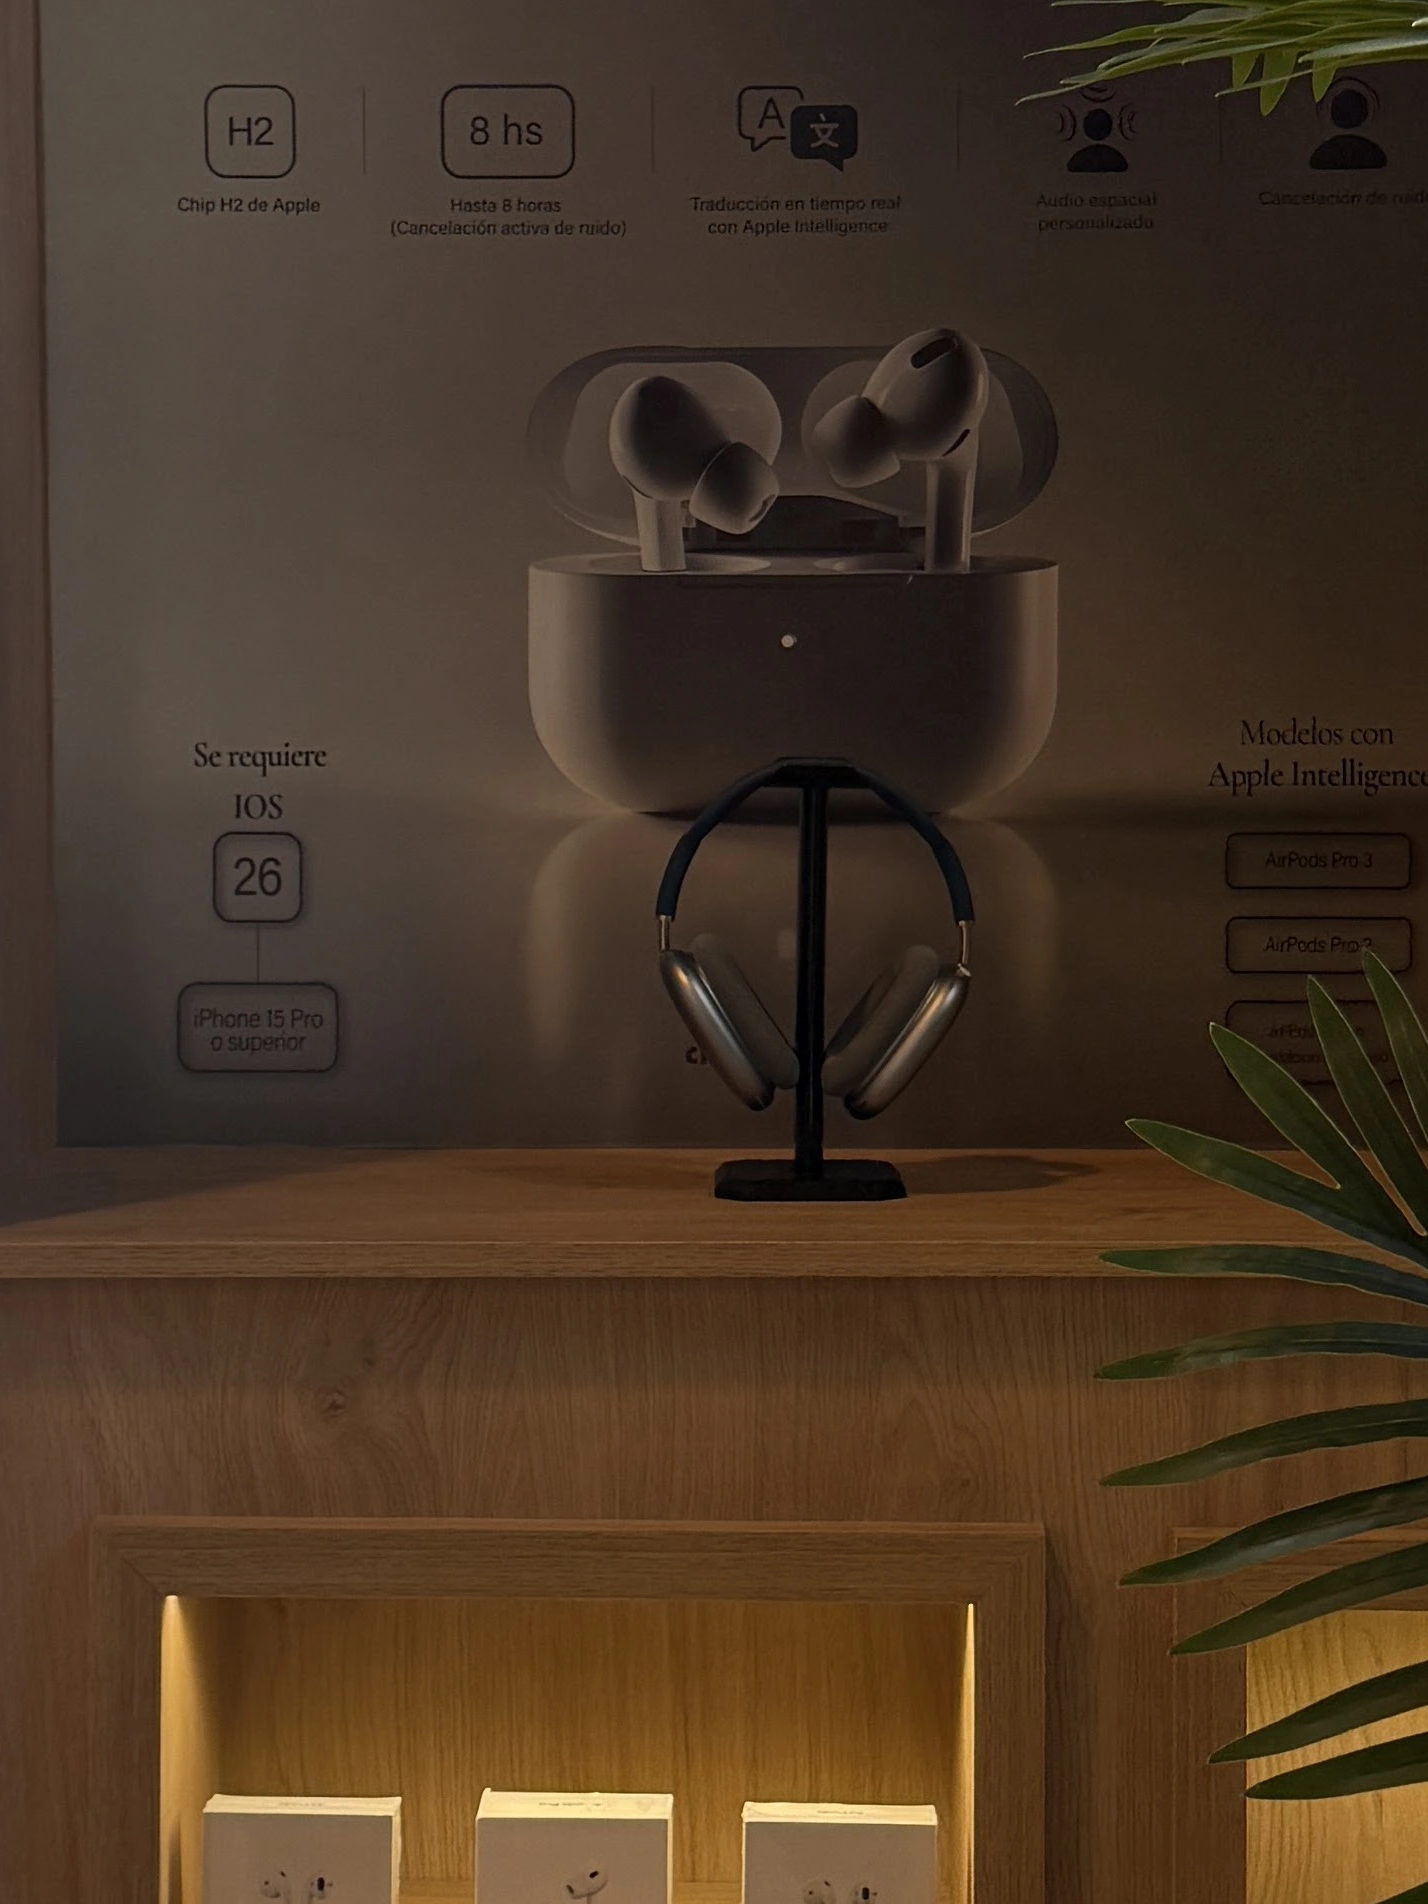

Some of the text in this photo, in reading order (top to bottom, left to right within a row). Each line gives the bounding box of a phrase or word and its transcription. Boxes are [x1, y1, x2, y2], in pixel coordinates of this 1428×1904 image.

[228, 117, 274, 145] H2
[471, 116, 543, 145] 8 hs
[177, 197, 320, 217] Chip H2 de Apple
[450, 197, 561, 214] Hasta 8 horas
[689, 196, 901, 217] Traducción en tiempo real
[1036, 192, 1158, 211] Audio espacial
[1369, 191, 1388, 206] de
[390, 219, 627, 238] (Cancelación activa de ruido)
[708, 218, 888, 238] con Apple Intelligence
[1039, 214, 1154, 232] personalizado
[1241, 717, 1394, 745] Modelos con
[193, 743, 327, 776] Se requiere
[1208, 759, 1284, 796] Apple
[234, 794, 283, 819] IOS
[1265, 851, 1373, 869] AirPods Pro 3
[234, 857, 282, 896] 26
[1264, 936, 1325, 953] AirPods
[1330, 936, 1359, 953] Pro
[193, 1009, 323, 1029] iPhone 15 Pro
[211, 1034, 306, 1055] o superior
